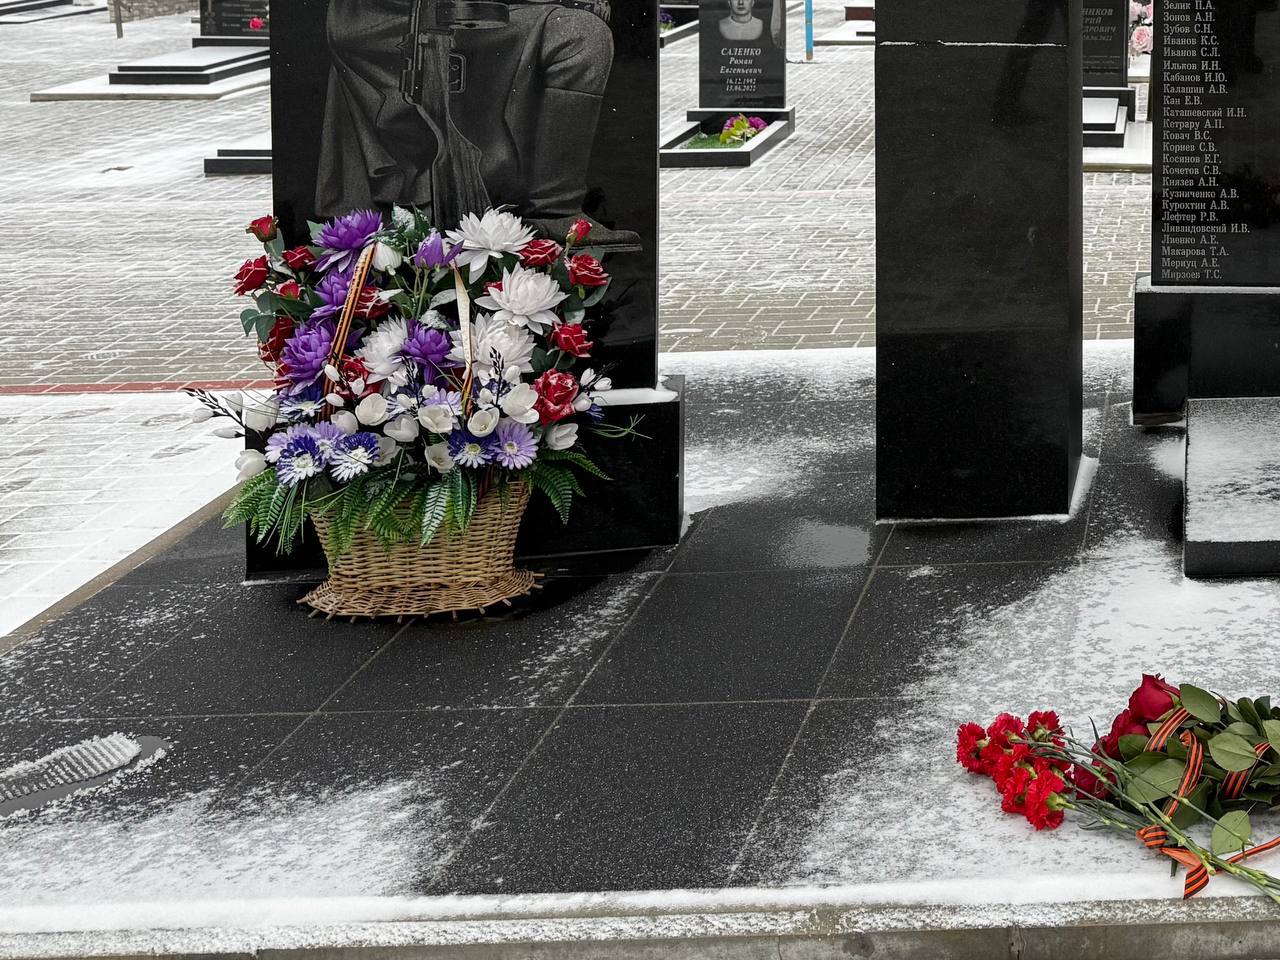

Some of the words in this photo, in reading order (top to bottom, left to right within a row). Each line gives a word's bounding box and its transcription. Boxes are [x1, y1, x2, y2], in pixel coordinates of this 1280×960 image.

[1163, 11, 1191, 21] Зонов
[1163, 35, 1197, 45] Иванов
[1163, 47, 1197, 57] Иванов
[1163, 72, 1201, 82] Кабанов
[1162, 141, 1196, 154] Корнев
[1162, 176, 1195, 186] Князев
[1162, 199, 1206, 212] Курохтин
[1162, 246, 1206, 258] Макарова
